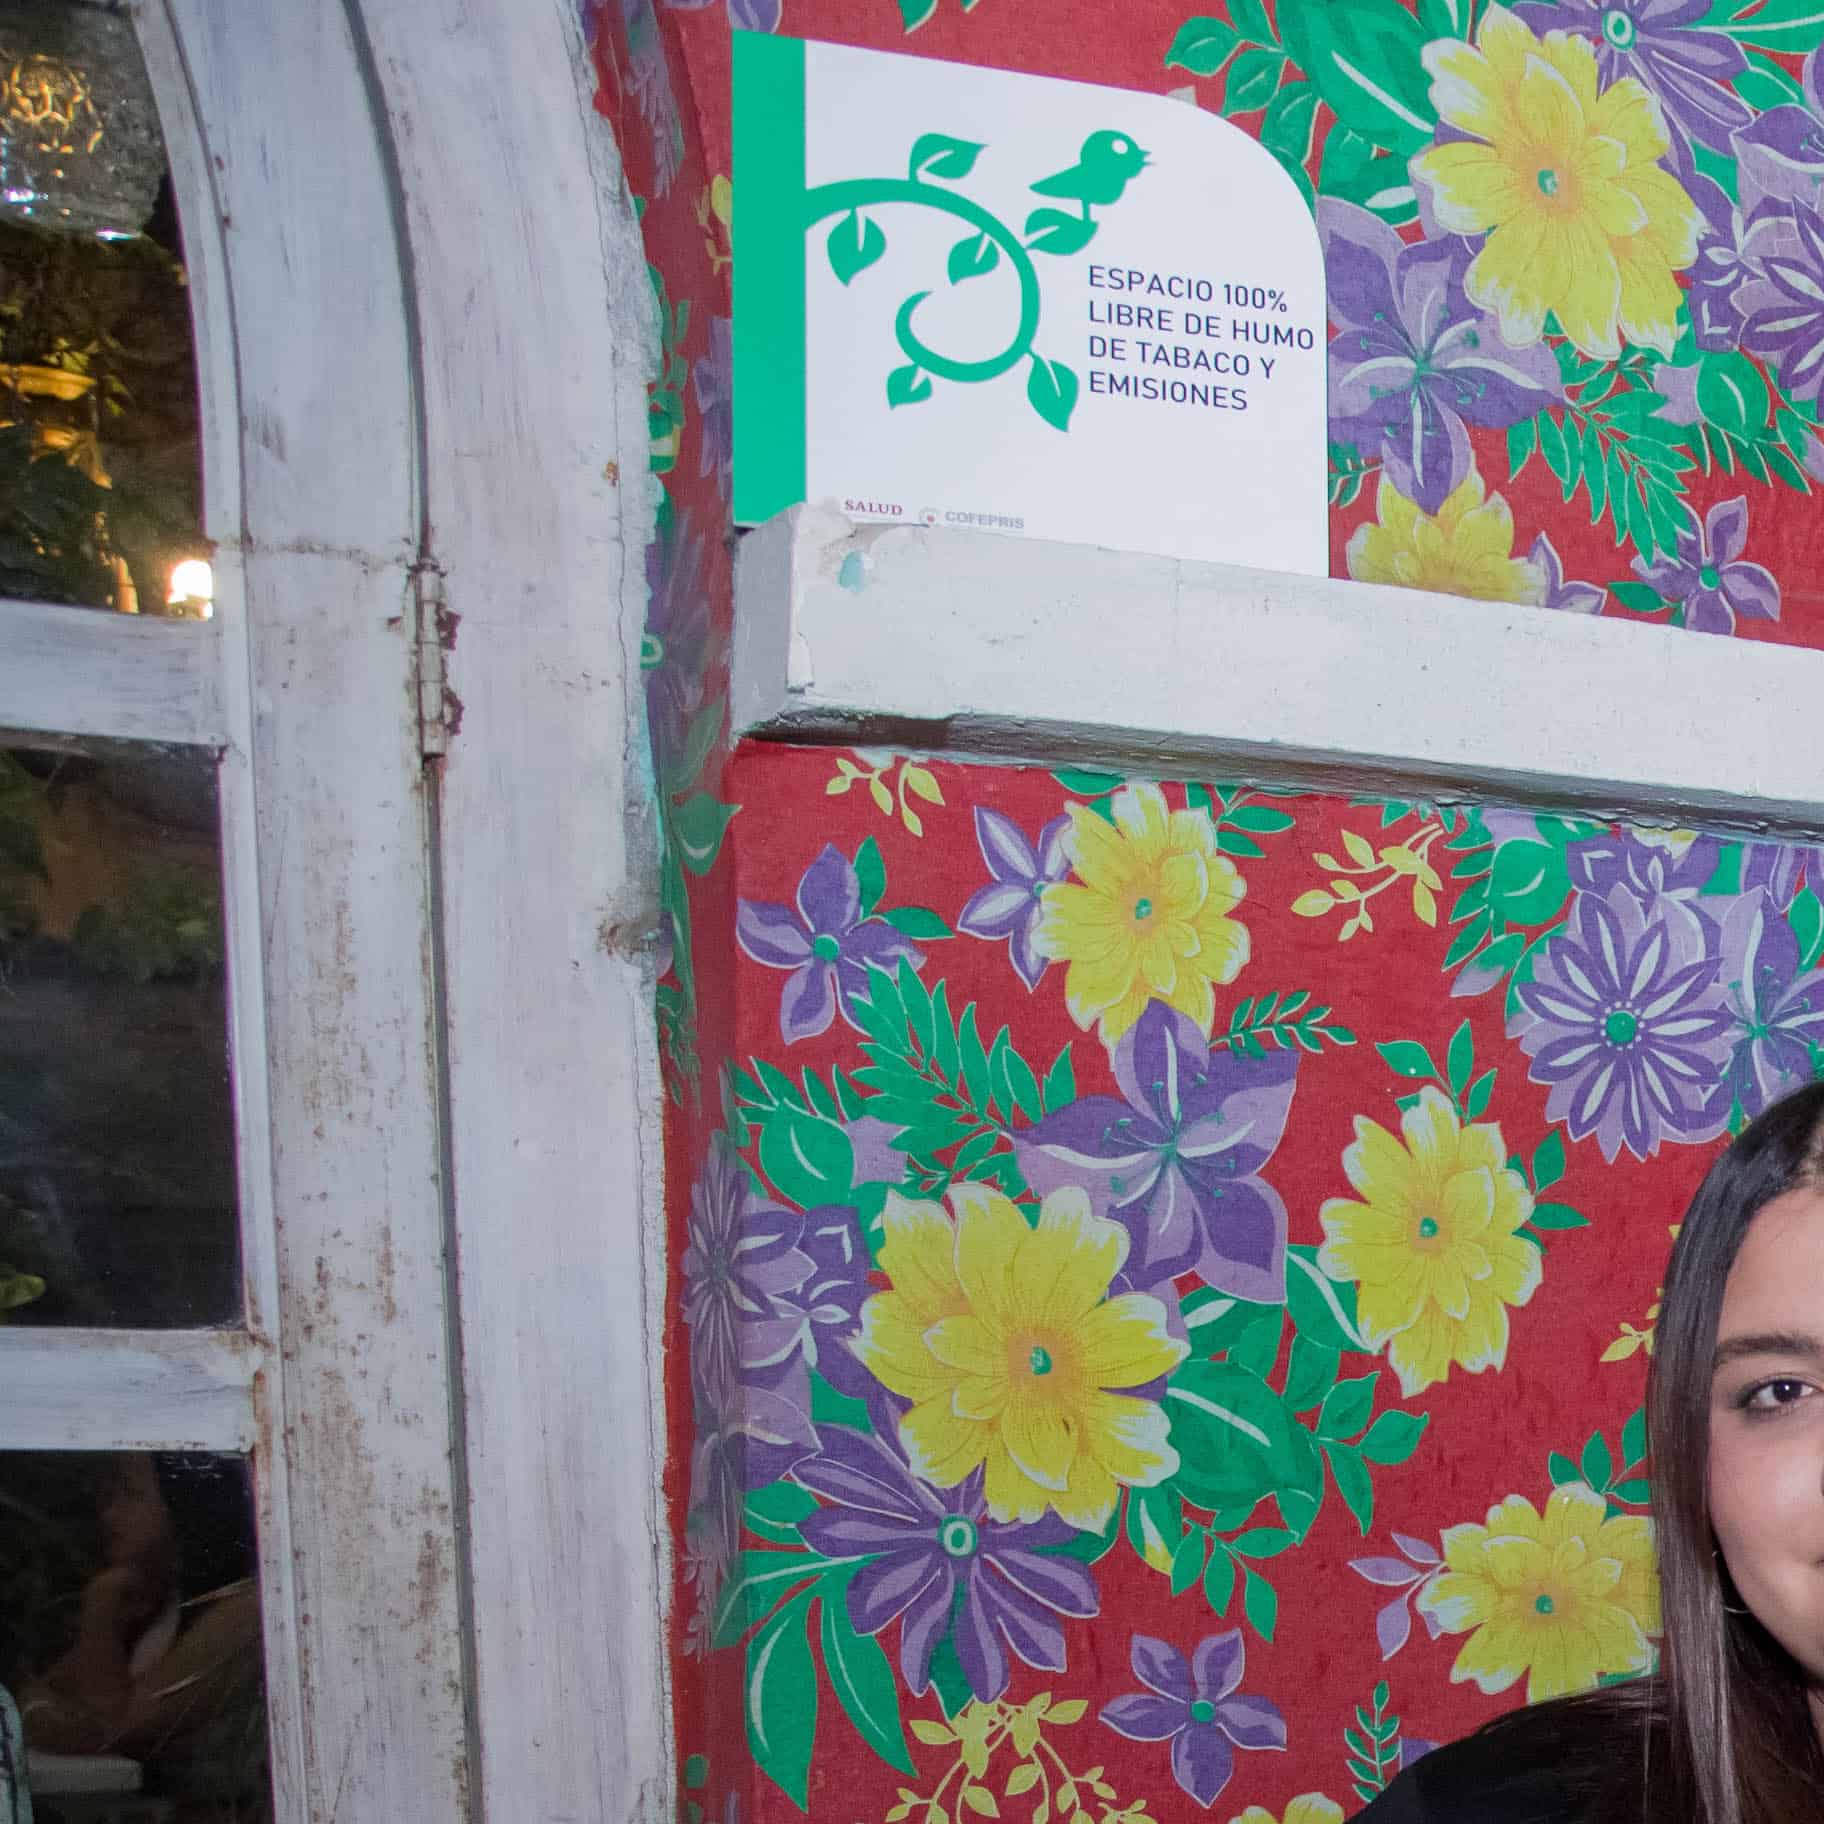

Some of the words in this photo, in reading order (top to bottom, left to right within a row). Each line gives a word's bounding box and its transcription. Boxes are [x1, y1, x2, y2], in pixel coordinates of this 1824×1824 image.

[1089, 265, 1213, 302] ESPACIO
[1223, 283, 1287, 312] 100%
[1089, 300, 1174, 332] LIBRE
[1185, 313, 1221, 338] DE
[1233, 319, 1314, 350] HUMO
[1089, 335, 1127, 361] DE
[1136, 340, 1250, 376] TABACO
[1260, 357, 1276, 379] Y
[1089, 370, 1248, 411] EMISIONES
[845, 499, 903, 516] SALUD
[945, 511, 1025, 529] COFEPRIS
